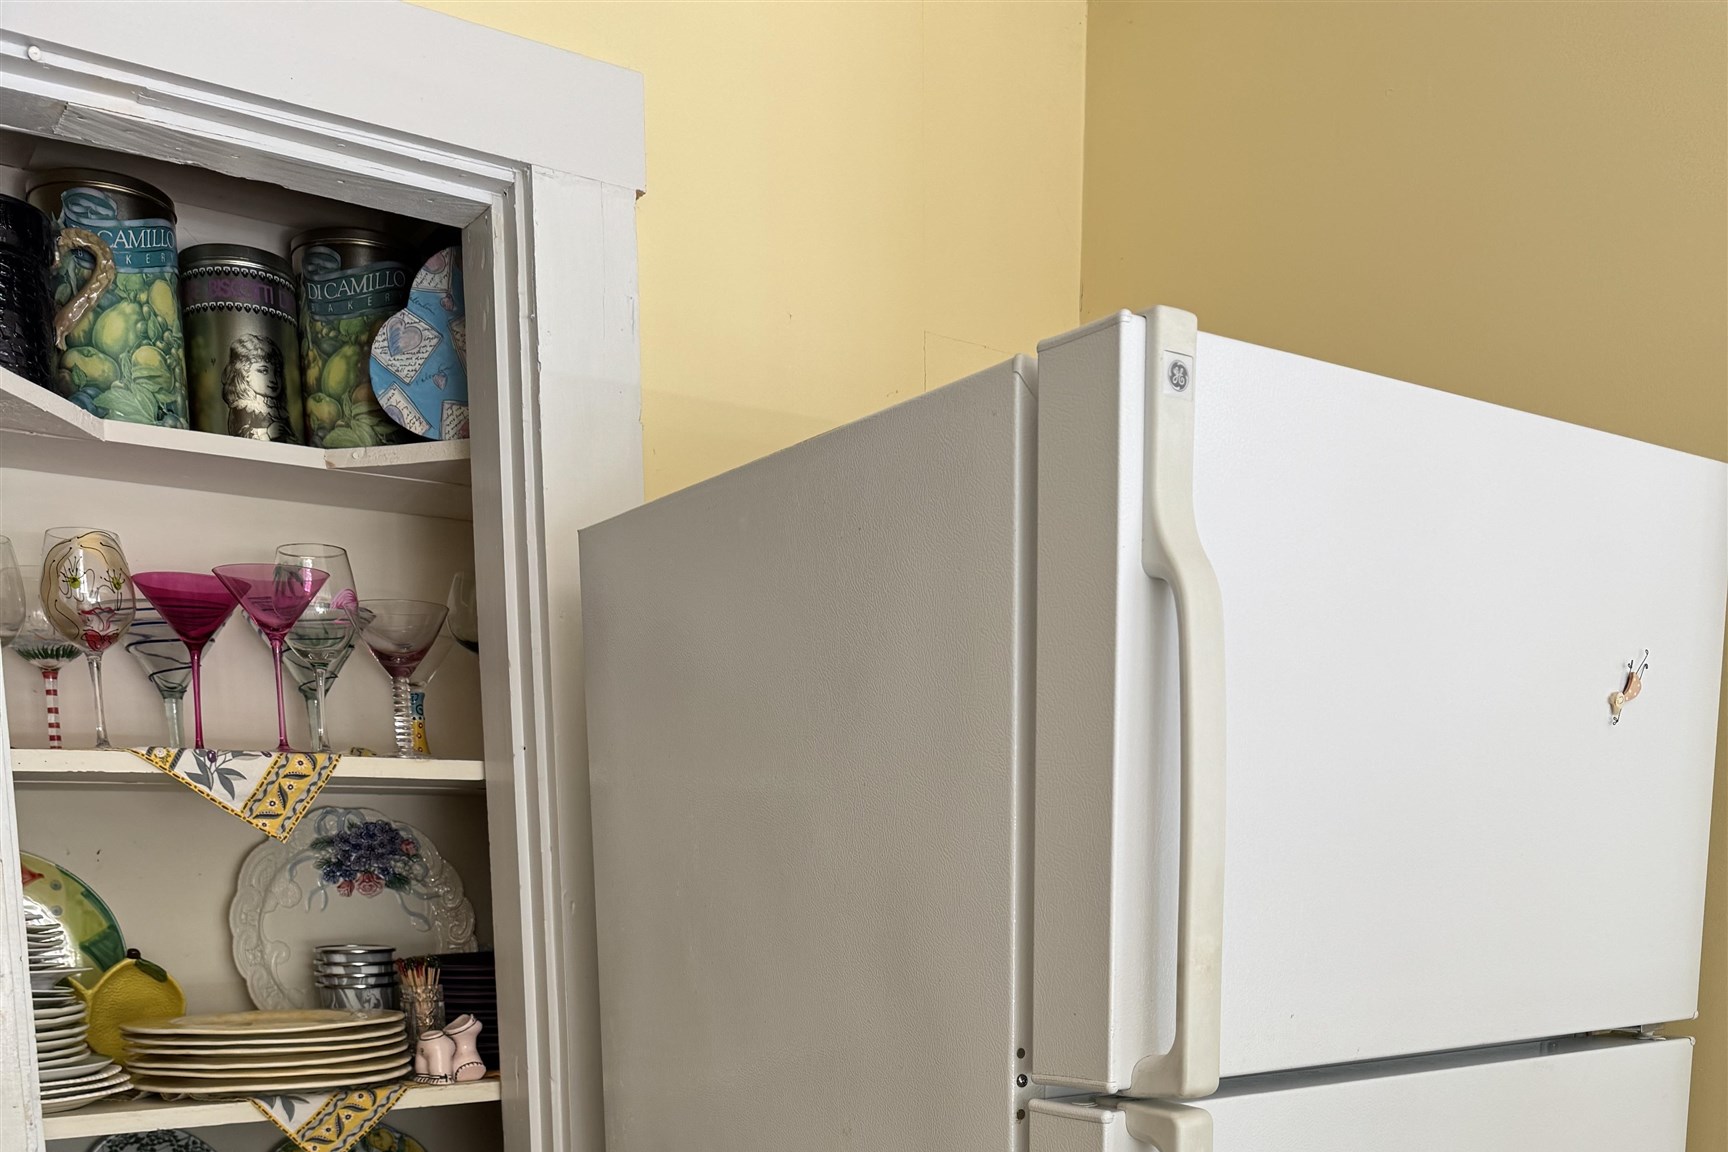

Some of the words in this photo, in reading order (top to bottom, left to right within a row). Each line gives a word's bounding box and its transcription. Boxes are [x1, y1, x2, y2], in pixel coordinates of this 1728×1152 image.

[97, 229, 174, 249] CAMILLO
[307, 282, 323, 300] DI
[323, 270, 406, 299] CAMILLO
